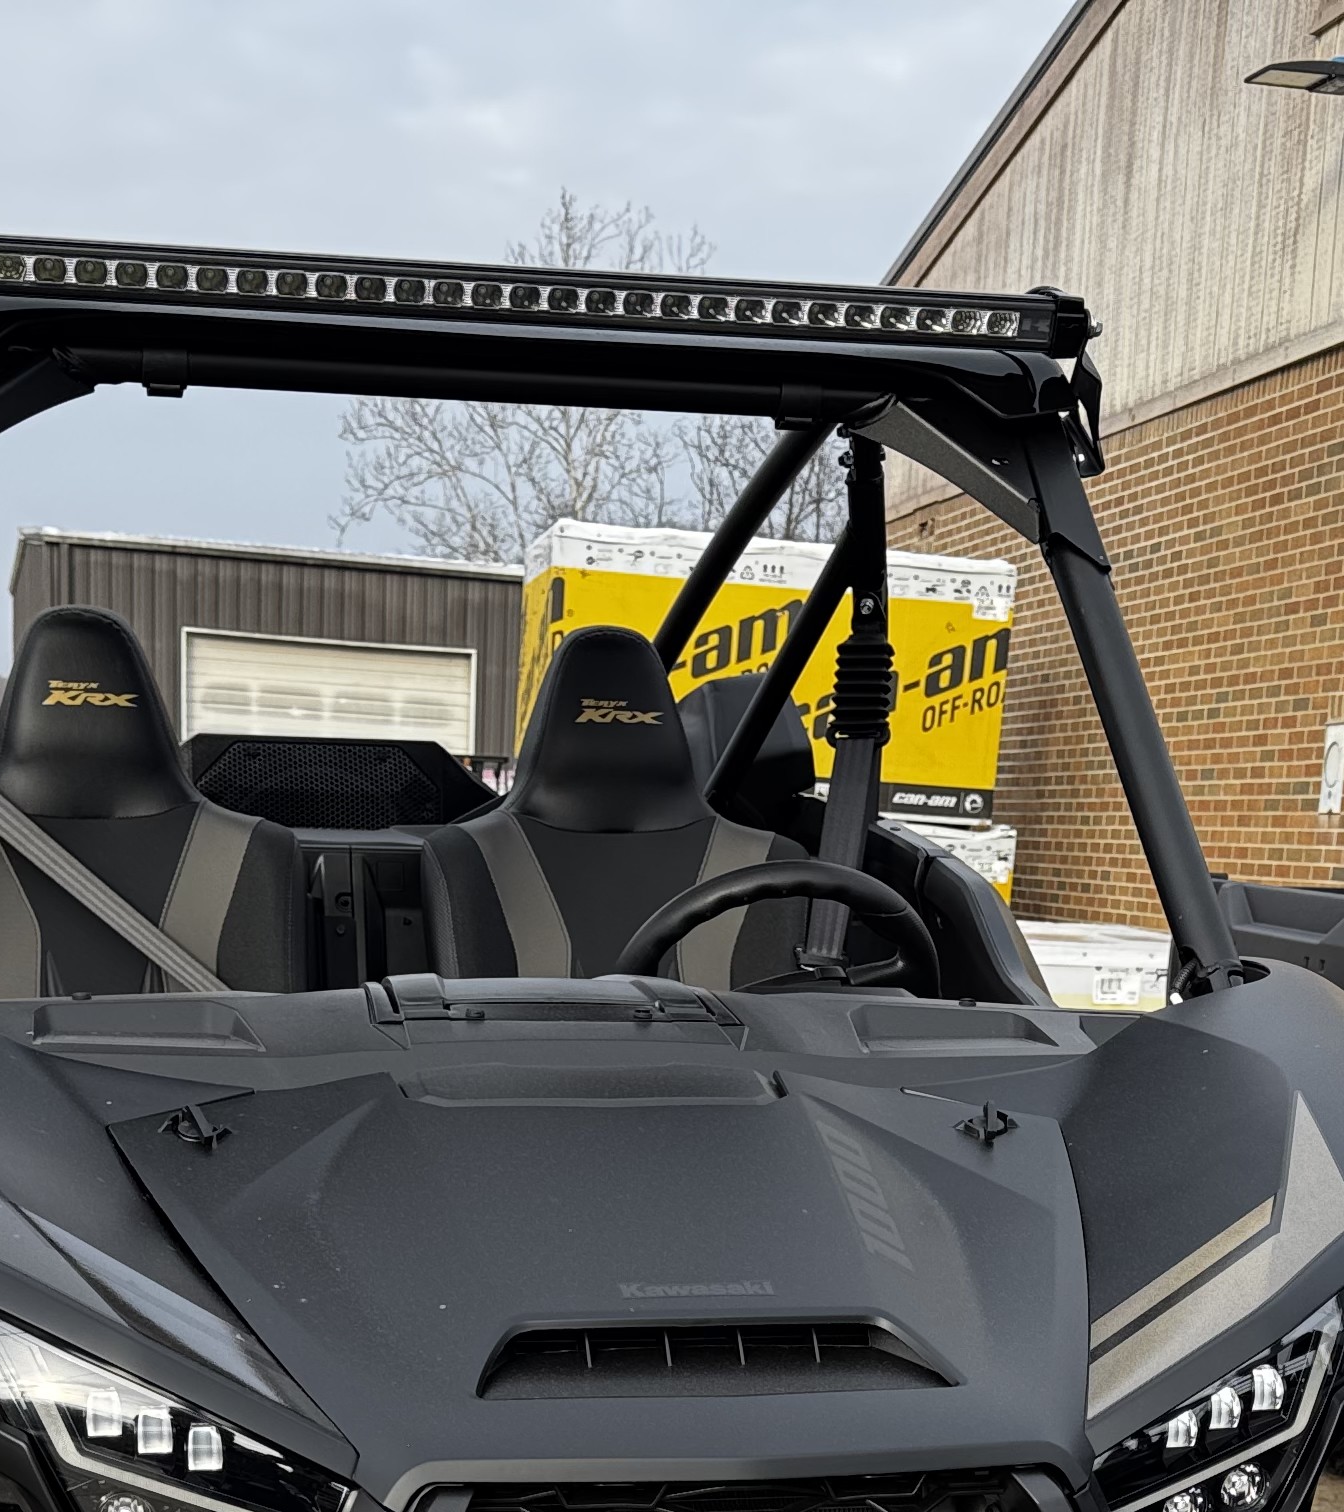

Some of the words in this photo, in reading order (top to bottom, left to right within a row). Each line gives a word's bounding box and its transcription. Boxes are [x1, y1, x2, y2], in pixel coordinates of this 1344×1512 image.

[669, 598, 806, 679] -am
[42, 690, 140, 707] KRX
[575, 708, 665, 725] KRX
[620, 1279, 776, 1298] Kawasaki
